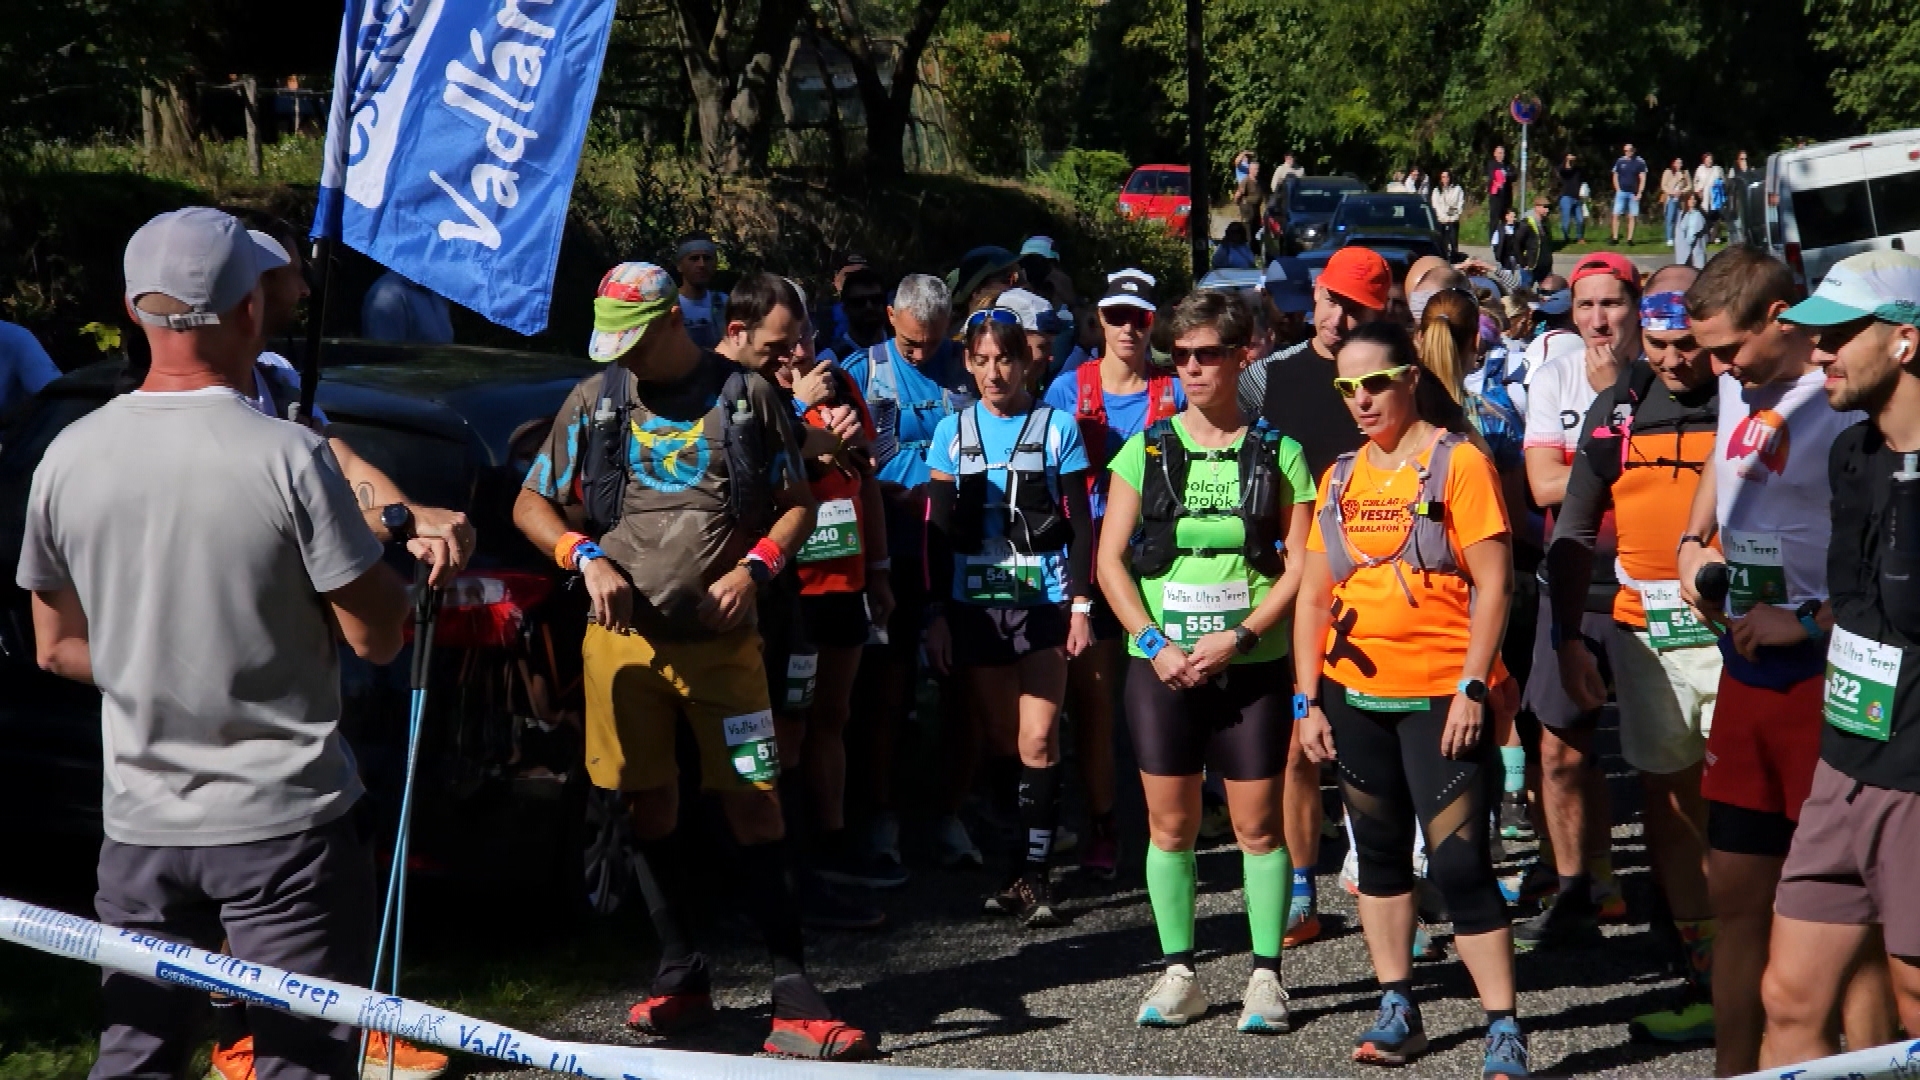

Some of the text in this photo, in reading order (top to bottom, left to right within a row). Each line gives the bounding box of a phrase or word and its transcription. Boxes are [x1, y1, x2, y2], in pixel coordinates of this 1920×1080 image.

[1186, 615, 1225, 632] 555
[1830, 671, 1861, 704] 522
[757, 741, 779, 760] 57
